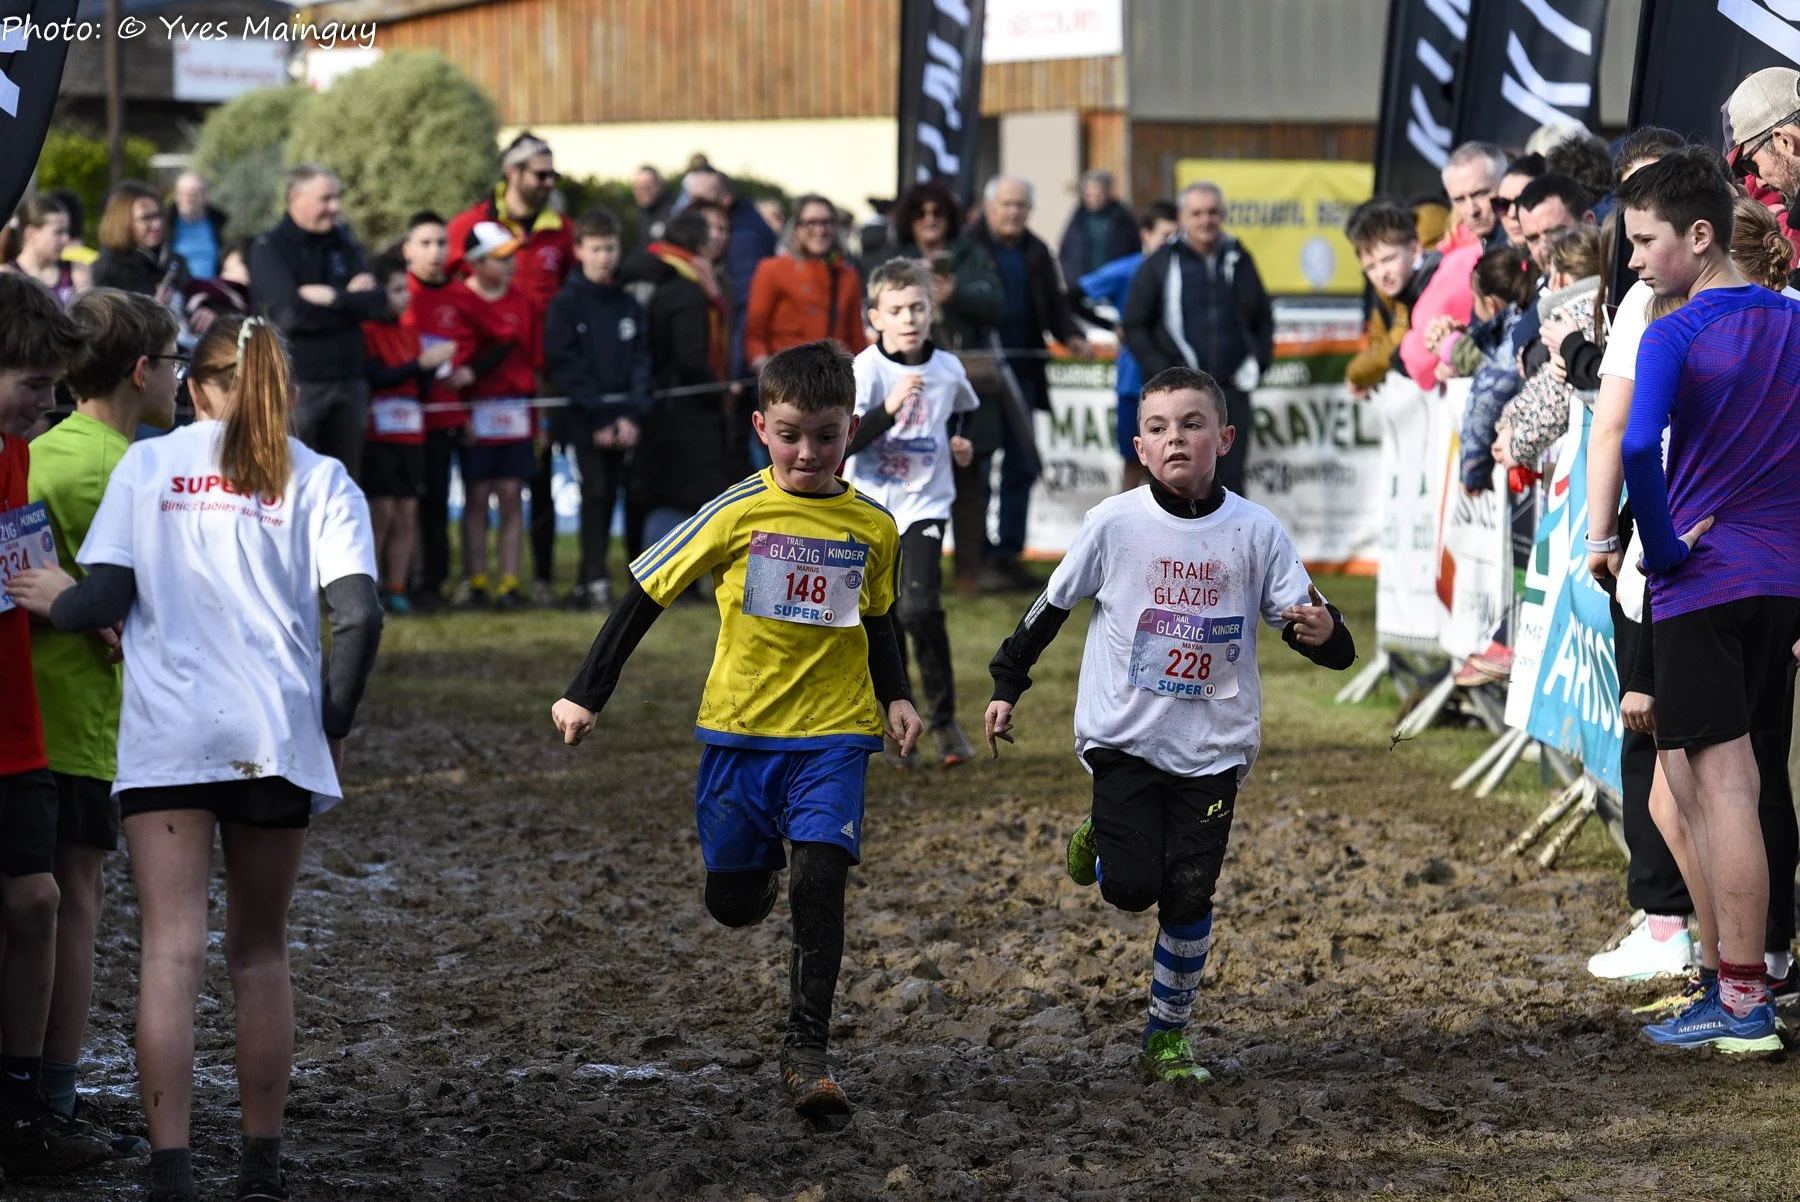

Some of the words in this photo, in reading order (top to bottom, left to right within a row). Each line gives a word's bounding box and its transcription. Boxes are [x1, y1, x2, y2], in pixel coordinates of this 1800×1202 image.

[171, 475, 252, 500] SUPE
[20, 509, 47, 527] KINDER
[786, 536, 805, 547] TRAIL
[769, 543, 820, 563] GLAZIG
[827, 547, 865, 561] KINDER
[796, 565, 820, 574] MARIUS
[1160, 561, 1214, 581] TRAIL
[785, 572, 828, 604] 148
[1153, 586, 1219, 607] GLAZIG
[773, 604, 820, 620] SUPER
[1172, 613, 1191, 625] TRAIL
[1156, 620, 1205, 642] GLAZIG
[1211, 624, 1241, 636] KINDER
[1182, 642, 1204, 651] MAYAN
[1165, 649, 1213, 681] 228
[1157, 680, 1202, 696] SUPER
[1678, 1020, 1725, 1034] MERRELL
